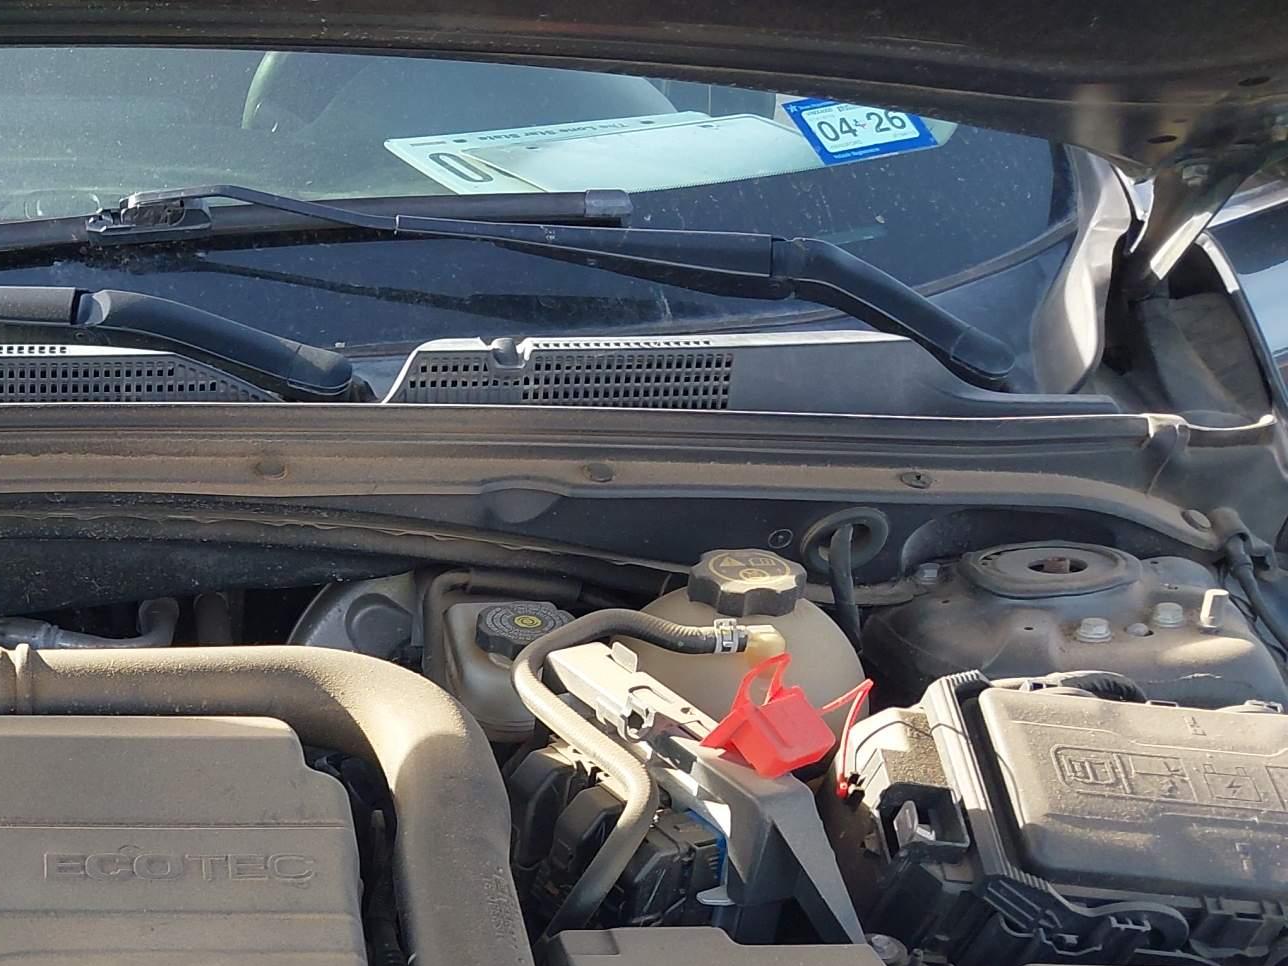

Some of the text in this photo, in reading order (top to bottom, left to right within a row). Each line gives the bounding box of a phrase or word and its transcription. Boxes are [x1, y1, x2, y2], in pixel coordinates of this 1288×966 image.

[559, 125, 597, 134] Lone
[817, 109, 906, 142] 04 26
[478, 132, 523, 142] State
[524, 128, 556, 138] Star
[43, 852, 318, 882] ECOTEC
